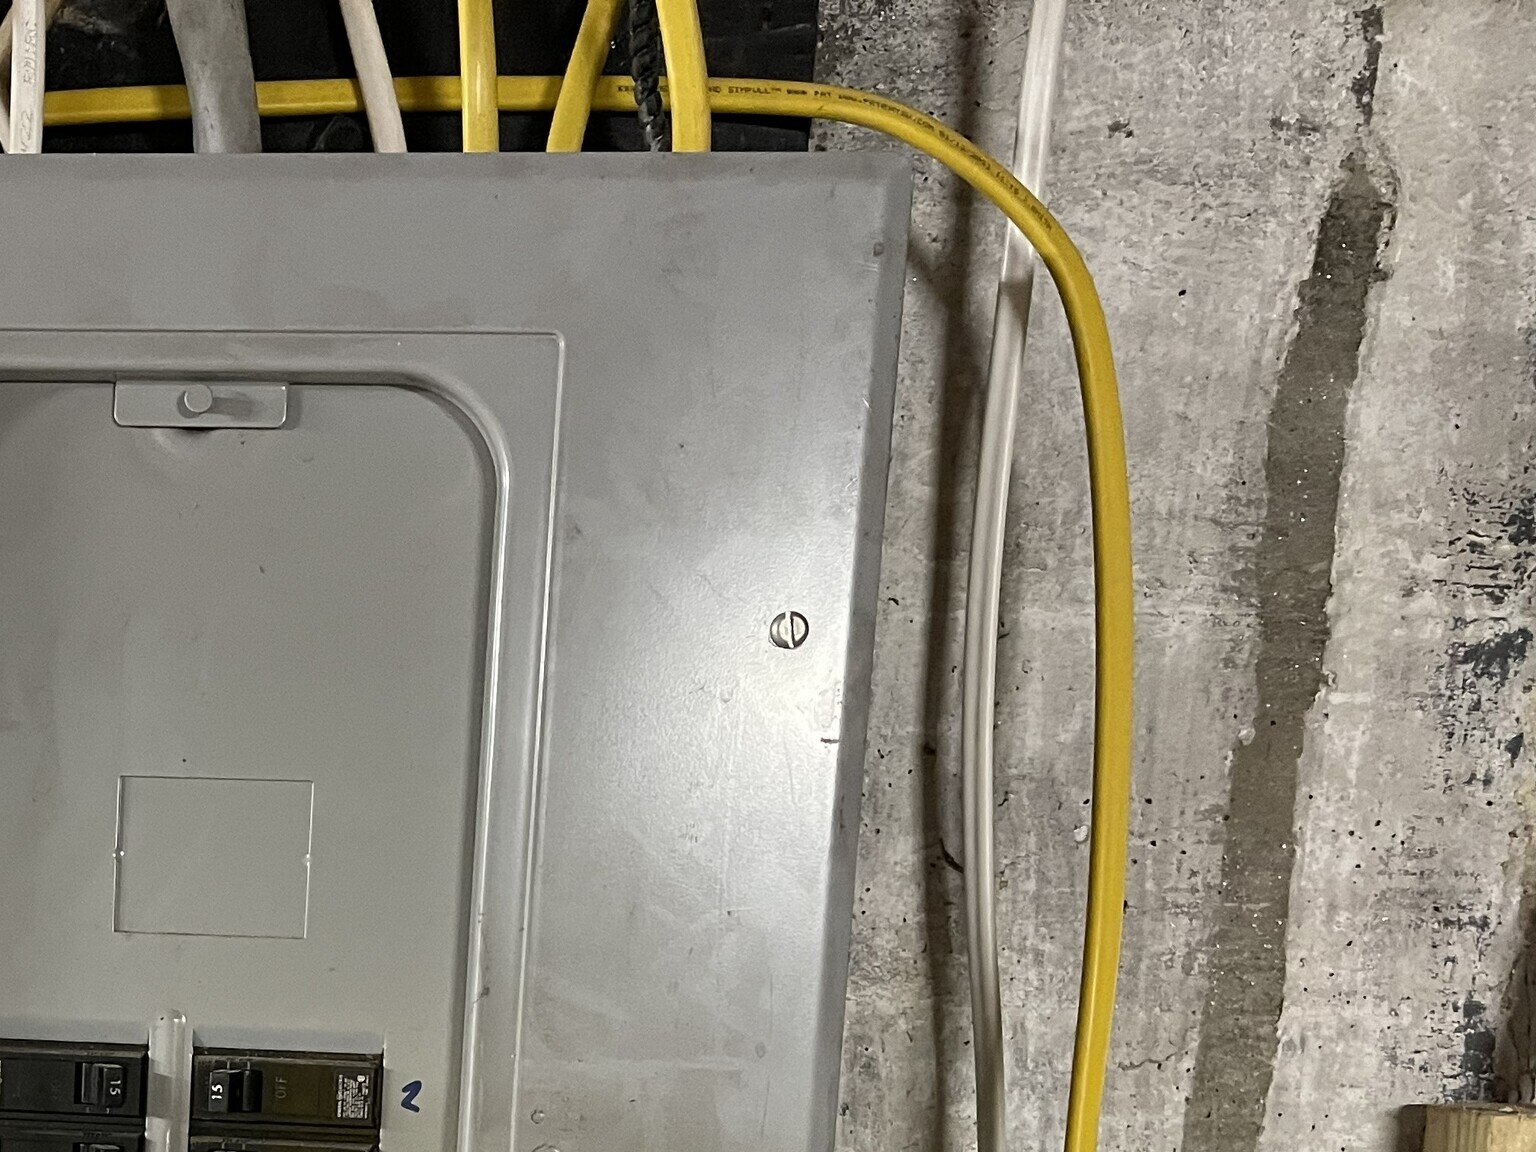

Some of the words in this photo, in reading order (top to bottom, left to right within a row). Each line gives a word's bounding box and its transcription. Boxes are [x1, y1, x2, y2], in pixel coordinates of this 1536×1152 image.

[109, 1079, 121, 1096] 15
[212, 1084, 223, 1101] 15
[275, 1076, 287, 1100] OFF
[401, 1081, 422, 1112] 2
